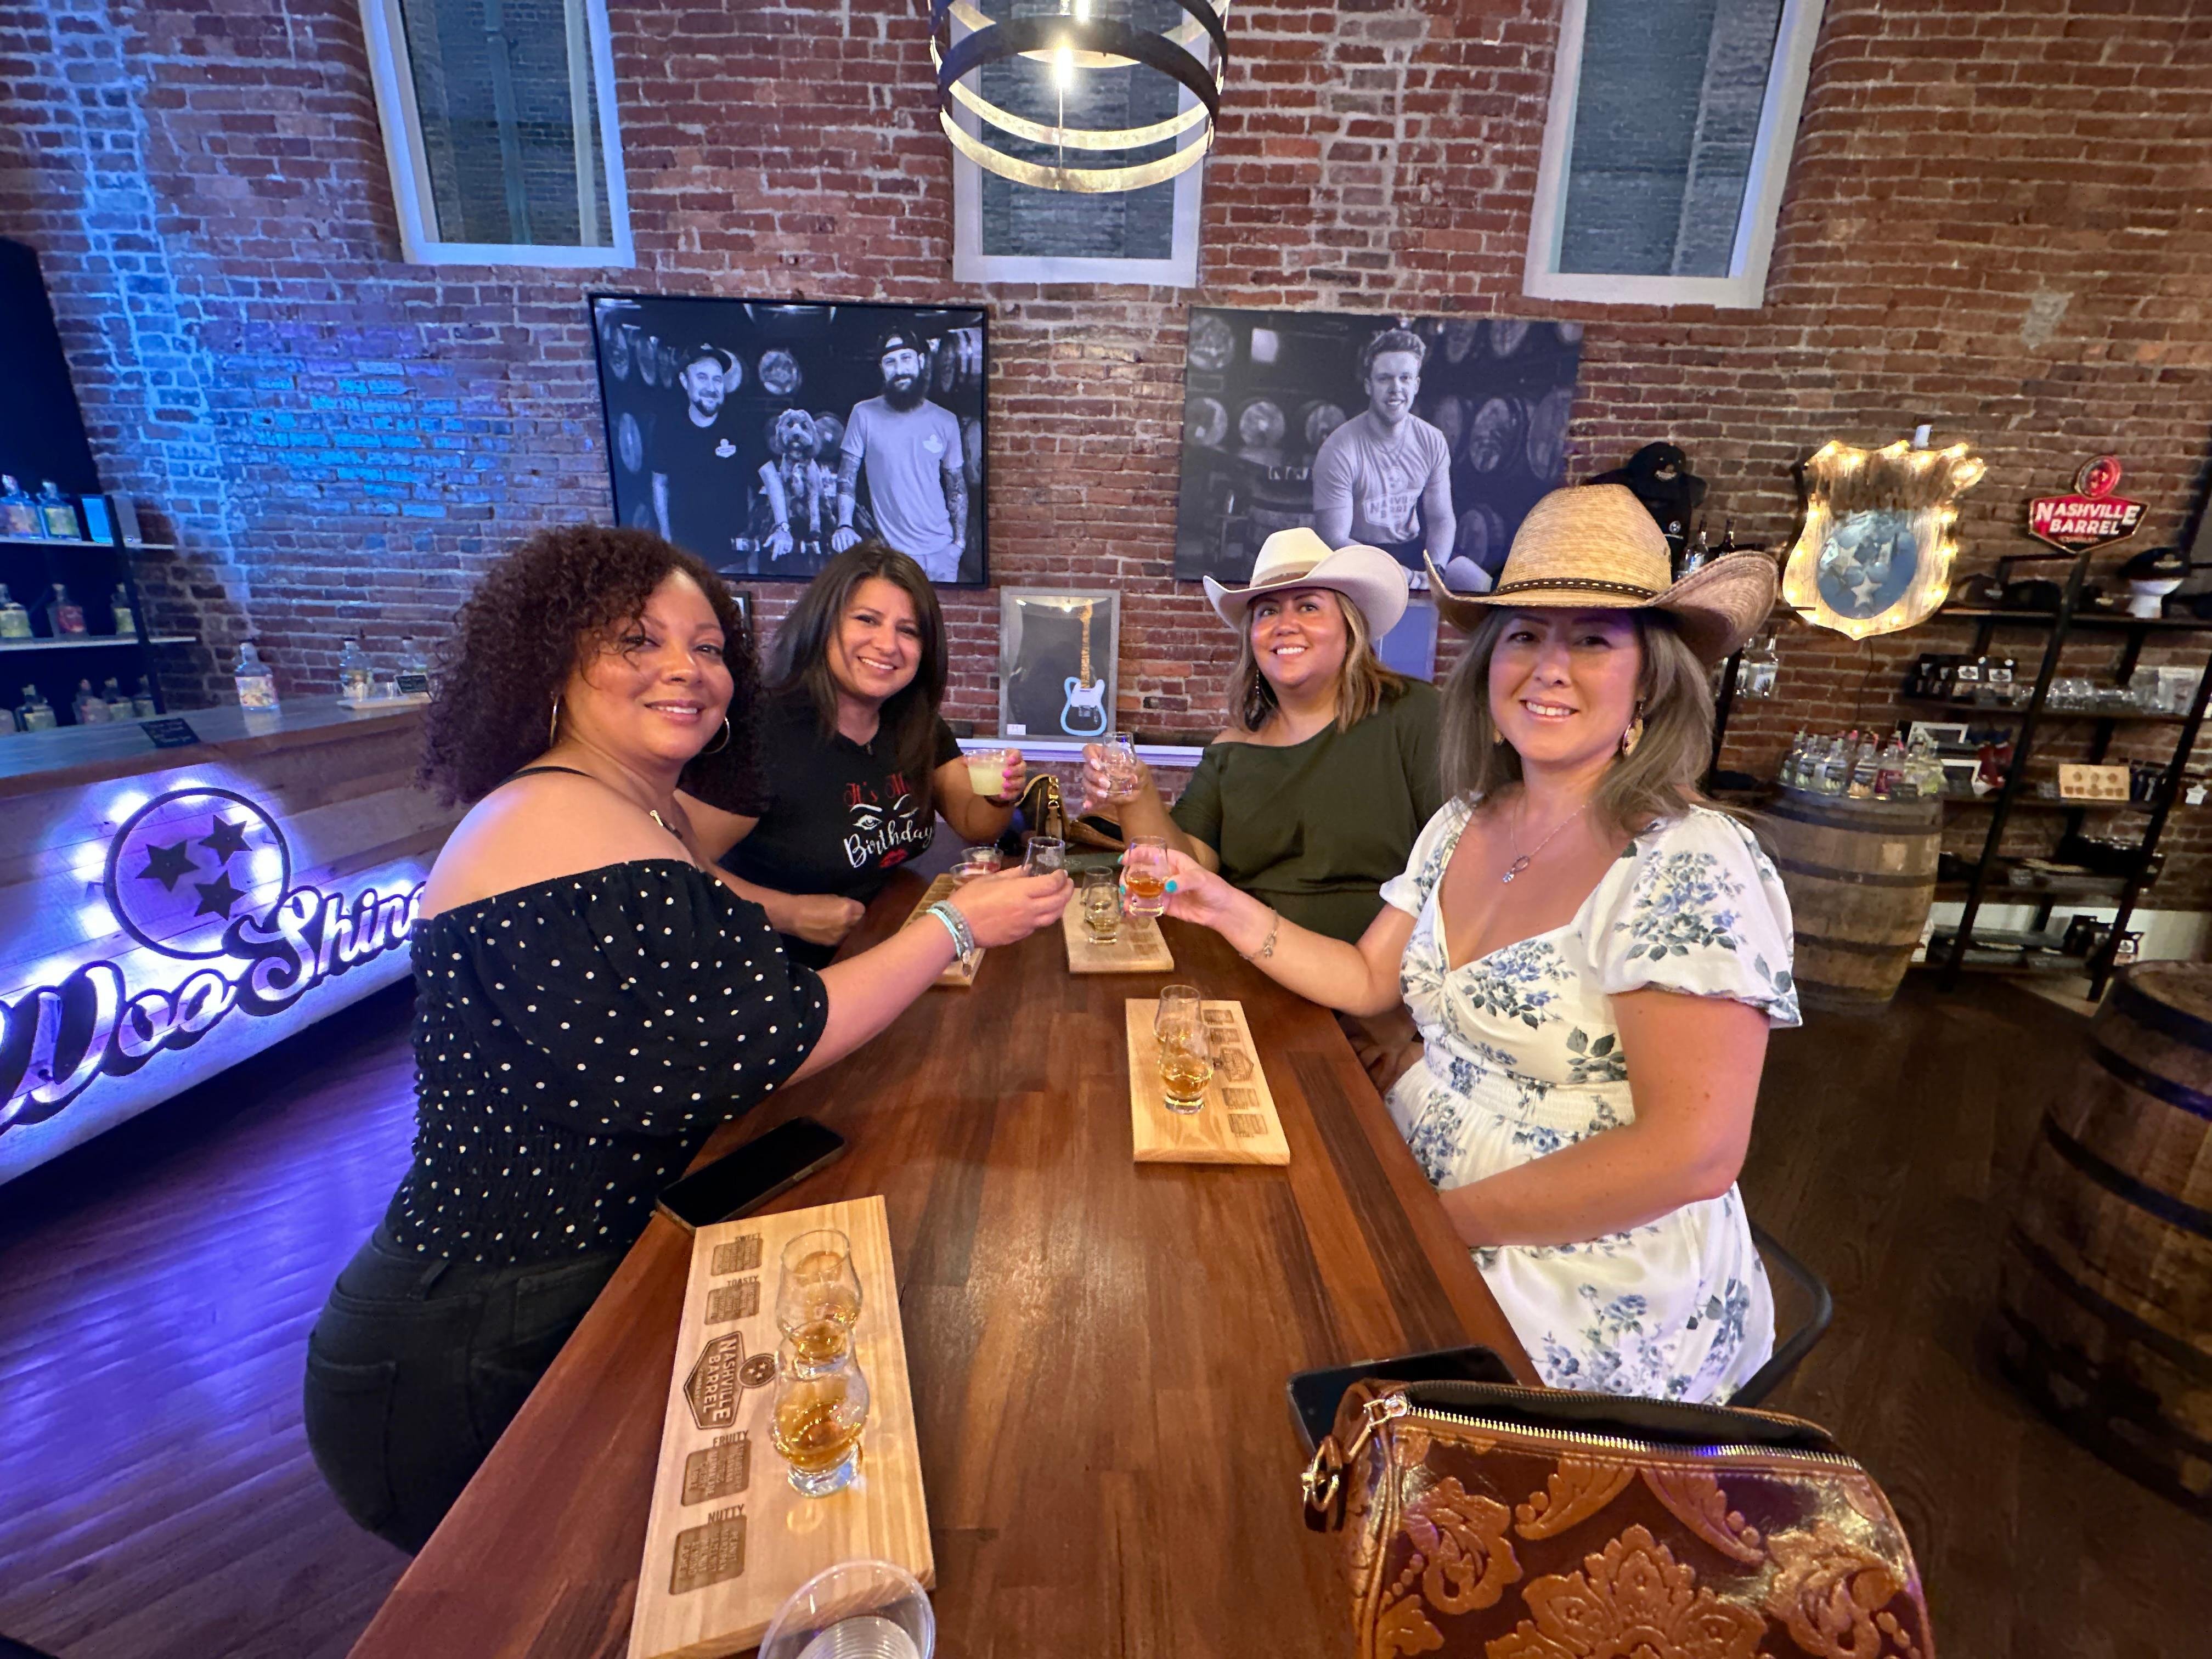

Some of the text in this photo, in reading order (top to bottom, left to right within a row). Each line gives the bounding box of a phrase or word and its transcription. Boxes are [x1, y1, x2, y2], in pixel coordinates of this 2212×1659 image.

[2035, 502, 2141, 525] NASHVILLE
[2049, 518, 2120, 535] BARREL
[884, 772, 912, 799] M
[843, 819, 933, 868] Birthday
[727, 1275, 759, 1288] TOASTY
[693, 1367, 704, 1399] COMPANY
[702, 1355, 721, 1414] BARREL
[712, 1338, 737, 1422] NASHVILLE
[713, 1430, 748, 1447] FRUITY
[708, 1504, 744, 1524] NUTTY
